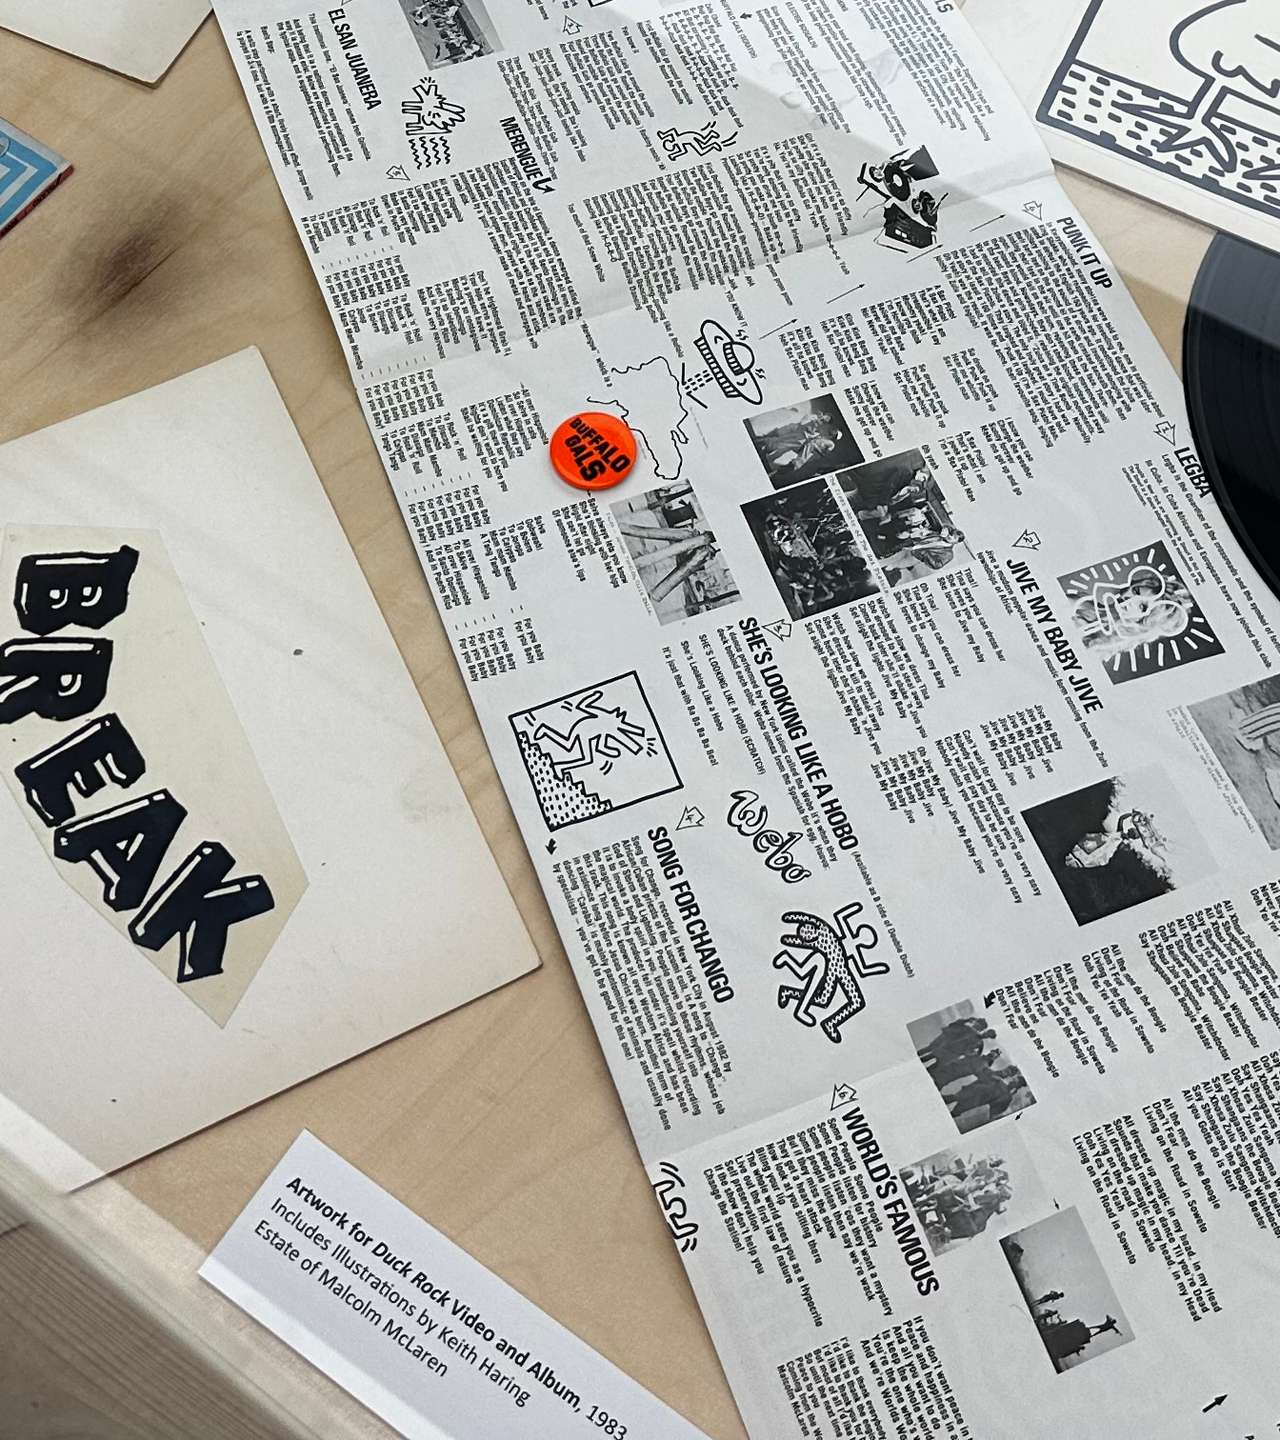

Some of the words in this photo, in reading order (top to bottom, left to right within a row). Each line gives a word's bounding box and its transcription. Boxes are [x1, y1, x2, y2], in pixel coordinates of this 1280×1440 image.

[327, 7, 346, 24] EL
[333, 22, 358, 50] SAN
[345, 52, 381, 110] JUANERA
[500, 116, 542, 180] MERENGUE
[1056, 216, 1091, 253] PUNK
[1079, 252, 1101, 265] IT
[1089, 267, 1112, 288] UP
[565, 434, 606, 481] GALS
[570, 418, 630, 472] BUFFALO
[1174, 446, 1213, 498] LEGBA
[1006, 559, 1039, 595] JIVE
[1026, 594, 1056, 623] MY
[1043, 626, 1082, 670] BABY
[1068, 674, 1103, 713] JIVE
[760, 665, 807, 740] LOOKING
[794, 741, 827, 782] LIKE
[811, 783, 833, 799] A
[820, 798, 858, 850] HOBO
[647, 826, 683, 879] SONG
[669, 880, 700, 920] FOR
[686, 918, 734, 1002] CHANGO
[816, 1121, 832, 1145] Some
[828, 1145, 846, 1175] People
[842, 1175, 858, 1201] listen
[859, 1216, 877, 1248] history
[826, 1117, 842, 1141] Some
[838, 1140, 856, 1171] People
[853, 1173, 869, 1199] Some
[865, 1200, 883, 1232] People
[842, 1107, 897, 1198] WORLD'S
[883, 1198, 939, 1295] FAMOUS
[806, 1125, 822, 1149] Some
[816, 1150, 836, 1179] people
[831, 1179, 847, 1205] listen
[851, 1225, 864, 1246] they
[860, 1247, 875, 1271] want
[873, 1279, 893, 1316] mystery
[254, 1219, 299, 1261] Estate
[300, 1258, 322, 1275] of
[317, 1268, 381, 1325] Malcolm
[382, 1318, 447, 1376] McLaren
[271, 1197, 331, 1250] Includes
[331, 1244, 416, 1316] Illustrations
[416, 1308, 438, 1334] by
[437, 1326, 477, 1364] Keith
[478, 1357, 530, 1407] Haring
[286, 1177, 348, 1229] Artwork
[347, 1222, 373, 1246] for
[371, 1241, 412, 1277] Duck
[410, 1271, 450, 1307] Rock
[451, 1298, 494, 1341] Video
[495, 1338, 530, 1367] and
[526, 1361, 580, 1412] Album,
[586, 1405, 627, 1440] 1983
